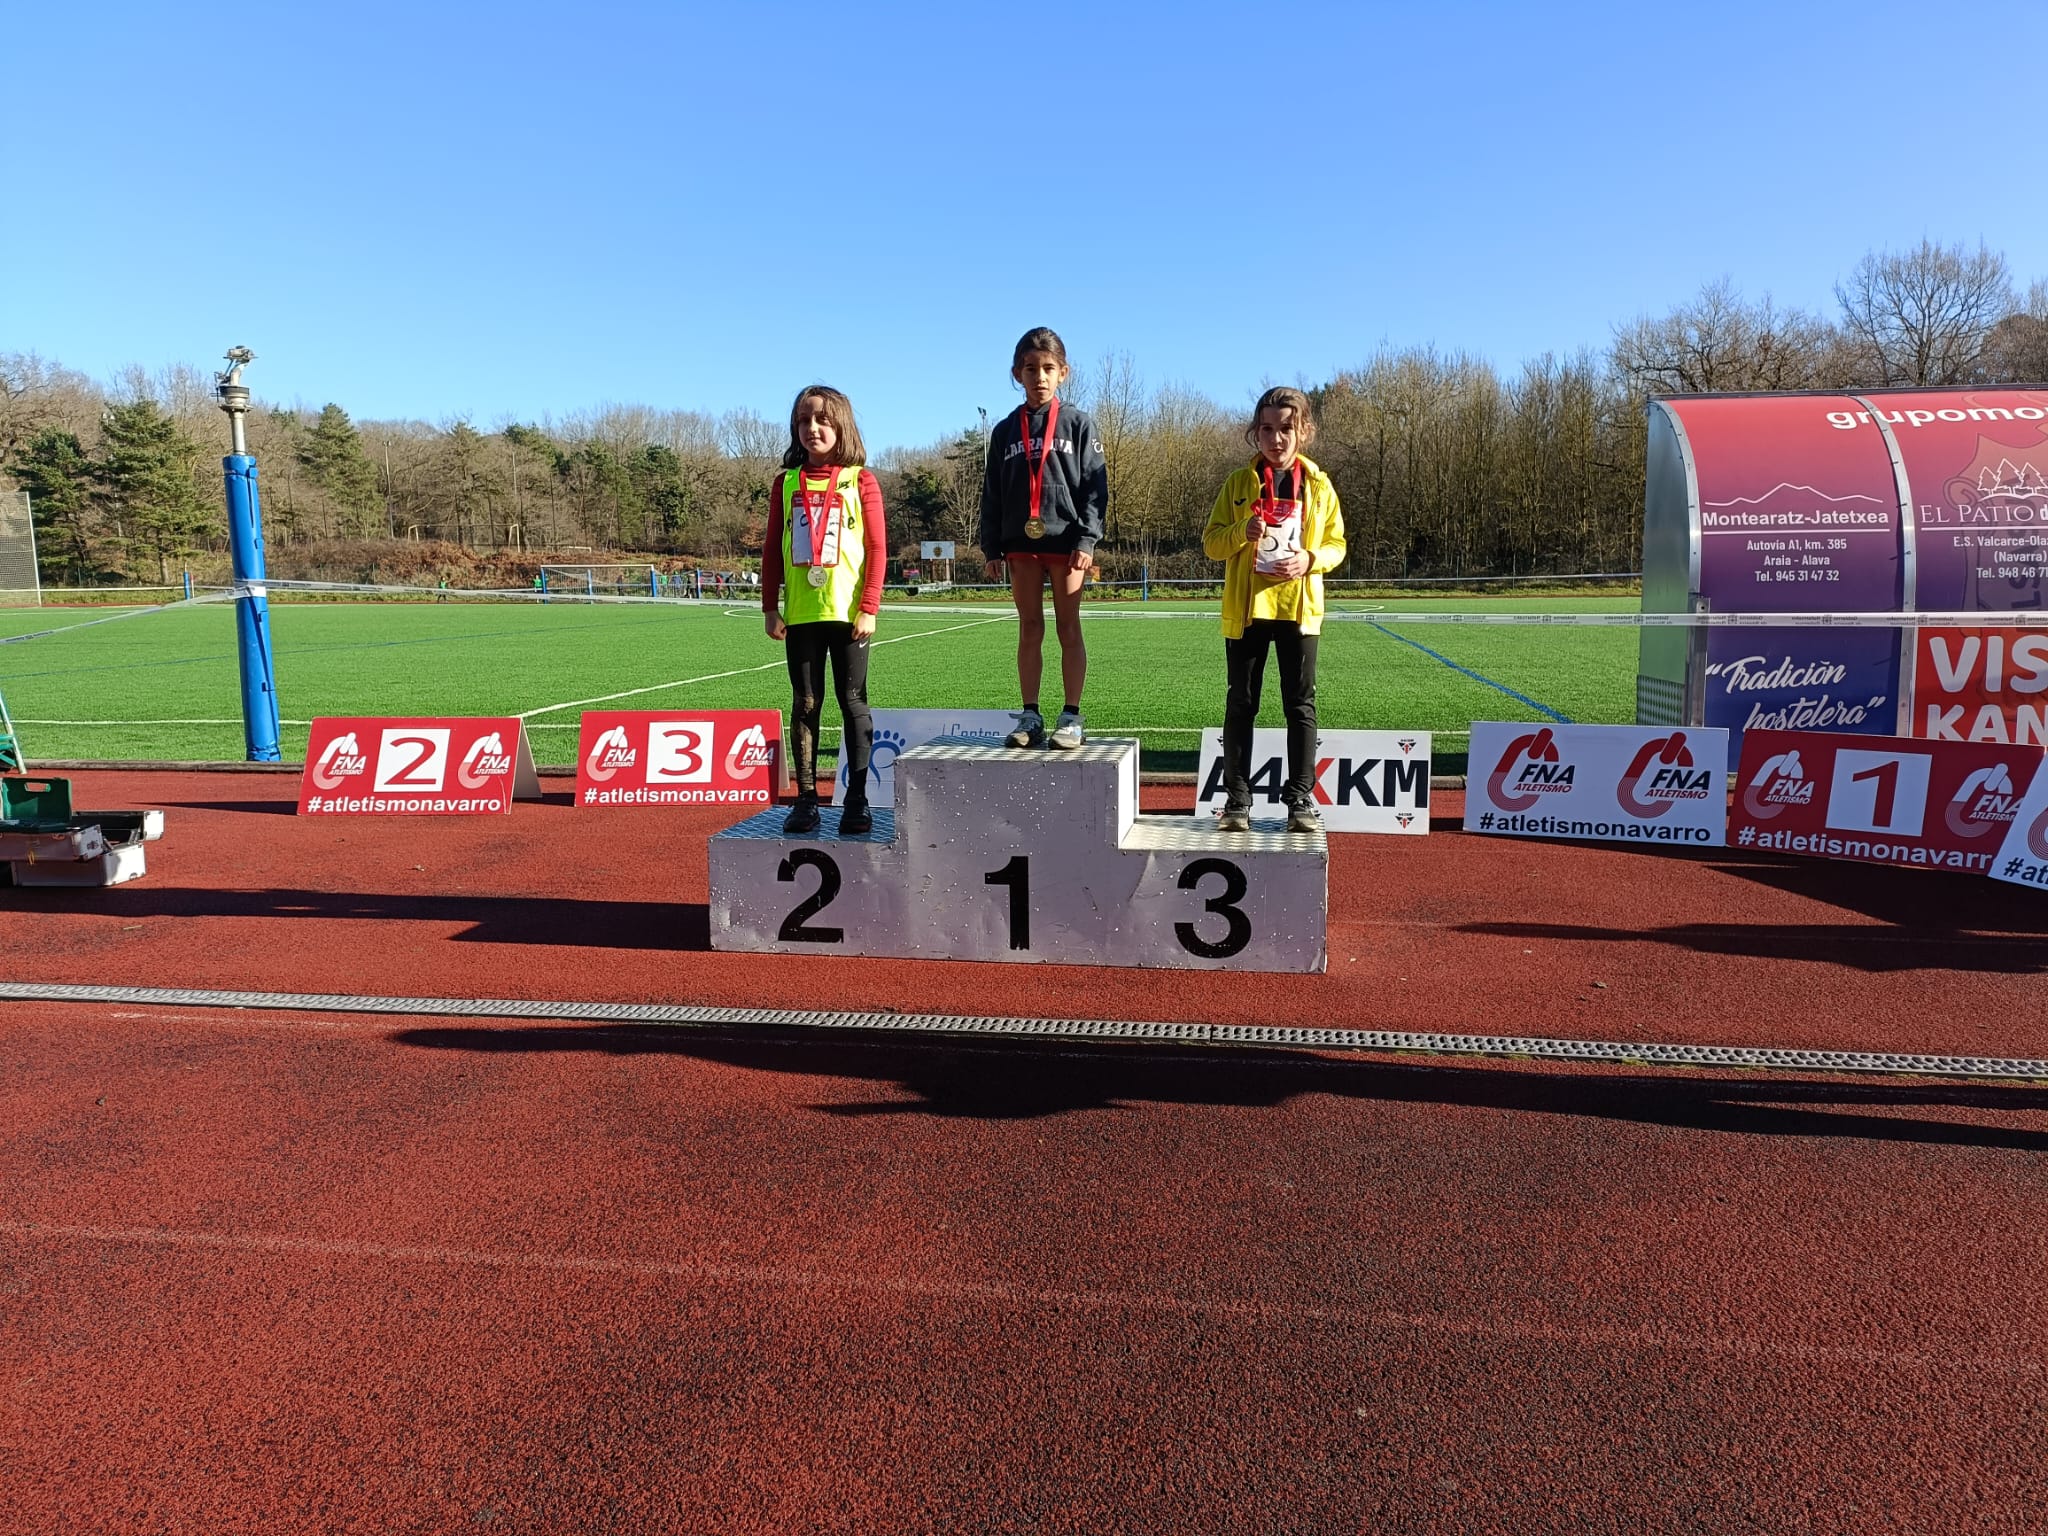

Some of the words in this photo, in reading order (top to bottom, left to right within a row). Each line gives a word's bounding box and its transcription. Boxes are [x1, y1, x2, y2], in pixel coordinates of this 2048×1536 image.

[1826, 406, 2048, 429] grupomo
[1004, 437, 1073, 460] LARRANA
[1702, 510, 1889, 526] Montearatz-Jatetxea
[1958, 504, 2034, 522] PATIO
[1804, 539, 1824, 550] km.
[1827, 538, 1847, 550] 385
[1953, 536, 1974, 547] E.S.
[1763, 554, 1791, 566] Araia
[1802, 554, 1830, 566] Alava
[1994, 550, 2047, 563] (Navarra)
[1755, 570, 1773, 581] Tel.
[1776, 570, 1795, 581] 945
[1797, 570, 1808, 581] 31
[1811, 570, 1823, 581] 47
[1826, 570, 1840, 581] 32
[1976, 567, 1995, 578] Tel.
[1998, 567, 2018, 578] 948
[2021, 567, 2035, 578] 46
[1929, 634, 2048, 693] VIS
[605, 748, 637, 762] FNA
[658, 729, 703, 776] 3
[742, 747, 774, 760] FNA
[332, 755, 367, 770] FNA
[384, 737, 437, 785] 2
[477, 755, 512, 769] FNA
[1518, 763, 1575, 784] FNA
[1649, 768, 1711, 790] FNA
[584, 788, 769, 804] #atletismonavarro
[1512, 783, 1573, 793] ATLETISMO
[1644, 789, 1709, 800] ATLETISMO
[1769, 779, 1816, 798] FNA
[1853, 760, 1900, 828] 1
[307, 796, 501, 812] #atletismonavarro
[1764, 795, 1811, 805] ATLETISMO
[1968, 810, 2015, 822] ATLETISM
[1479, 812, 1711, 842] #atletismonavarro
[1738, 826, 1993, 870] #atletismonavarr
[2003, 857, 2048, 885] #at
[776, 848, 844, 943] 2
[984, 855, 1030, 951] 1
[1173, 858, 1252, 959] 3
